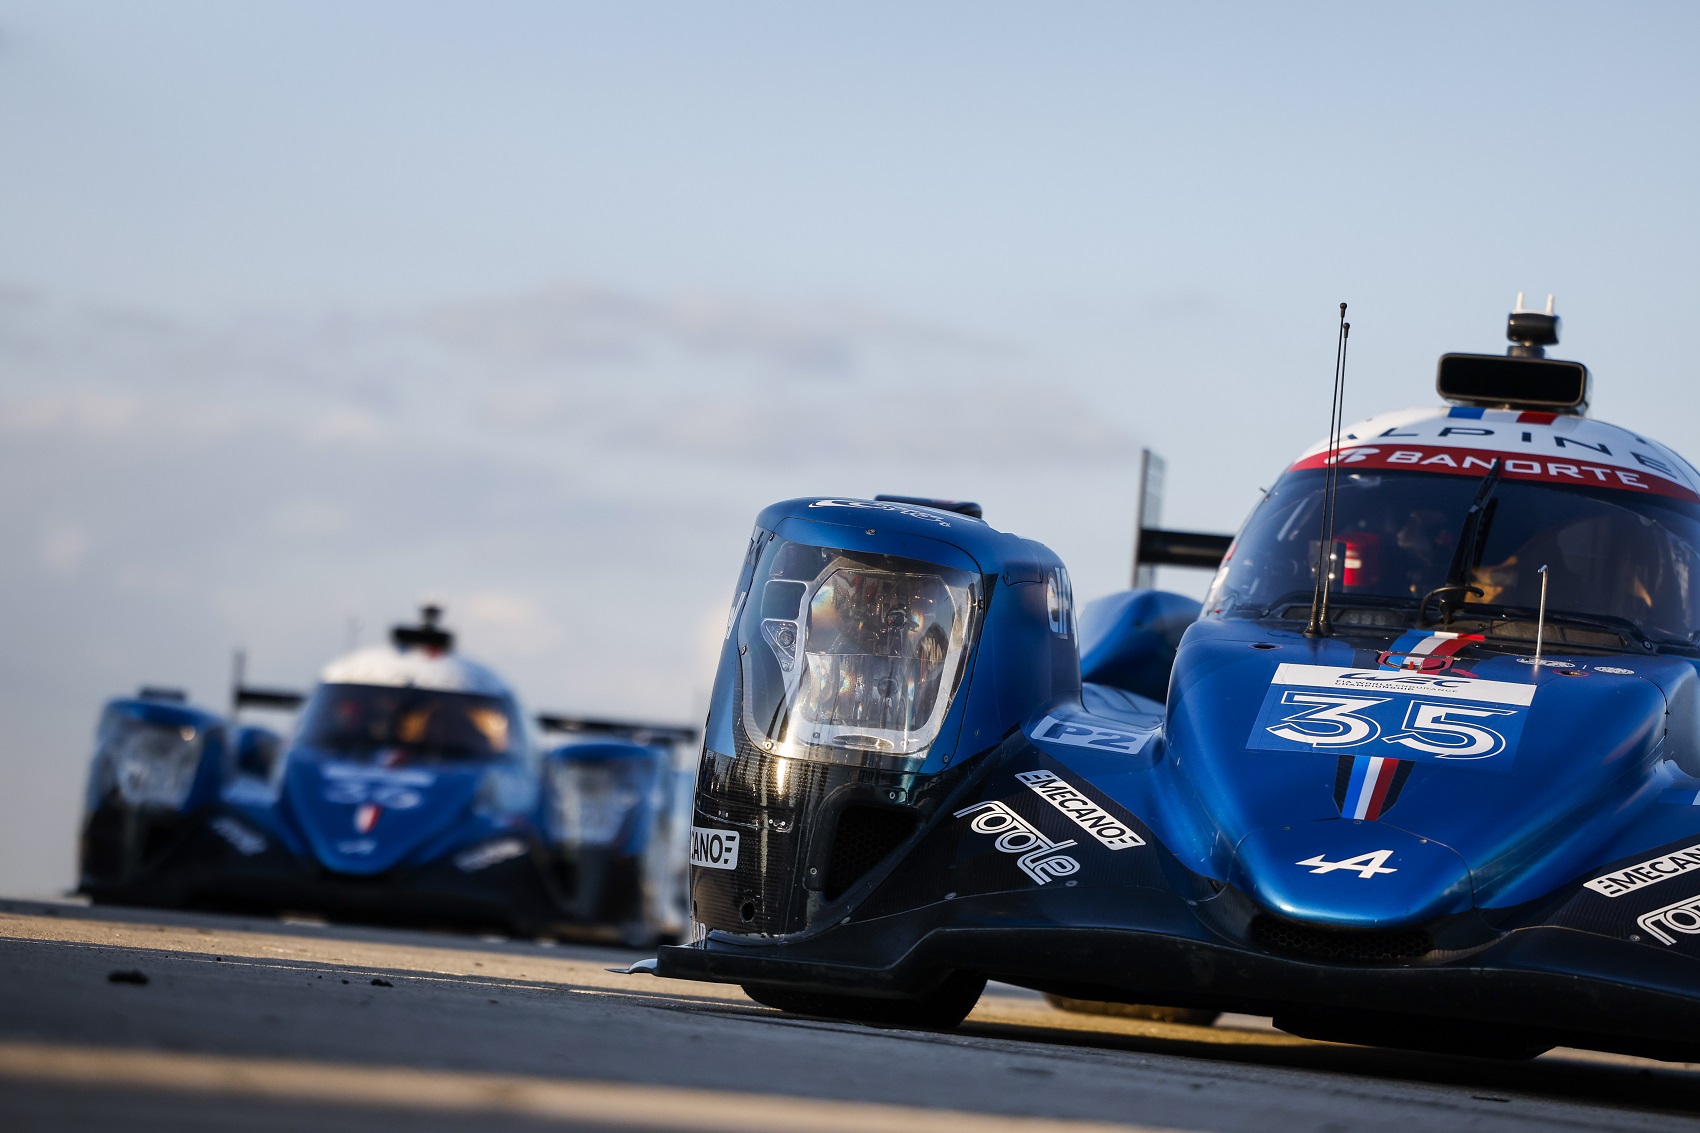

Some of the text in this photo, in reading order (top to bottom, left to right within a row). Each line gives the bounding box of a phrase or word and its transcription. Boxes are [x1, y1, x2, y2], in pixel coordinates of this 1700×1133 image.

[1385, 450, 1650, 489] BANORTE
[1042, 722, 1138, 751] P2
[1265, 690, 1519, 760] 35
